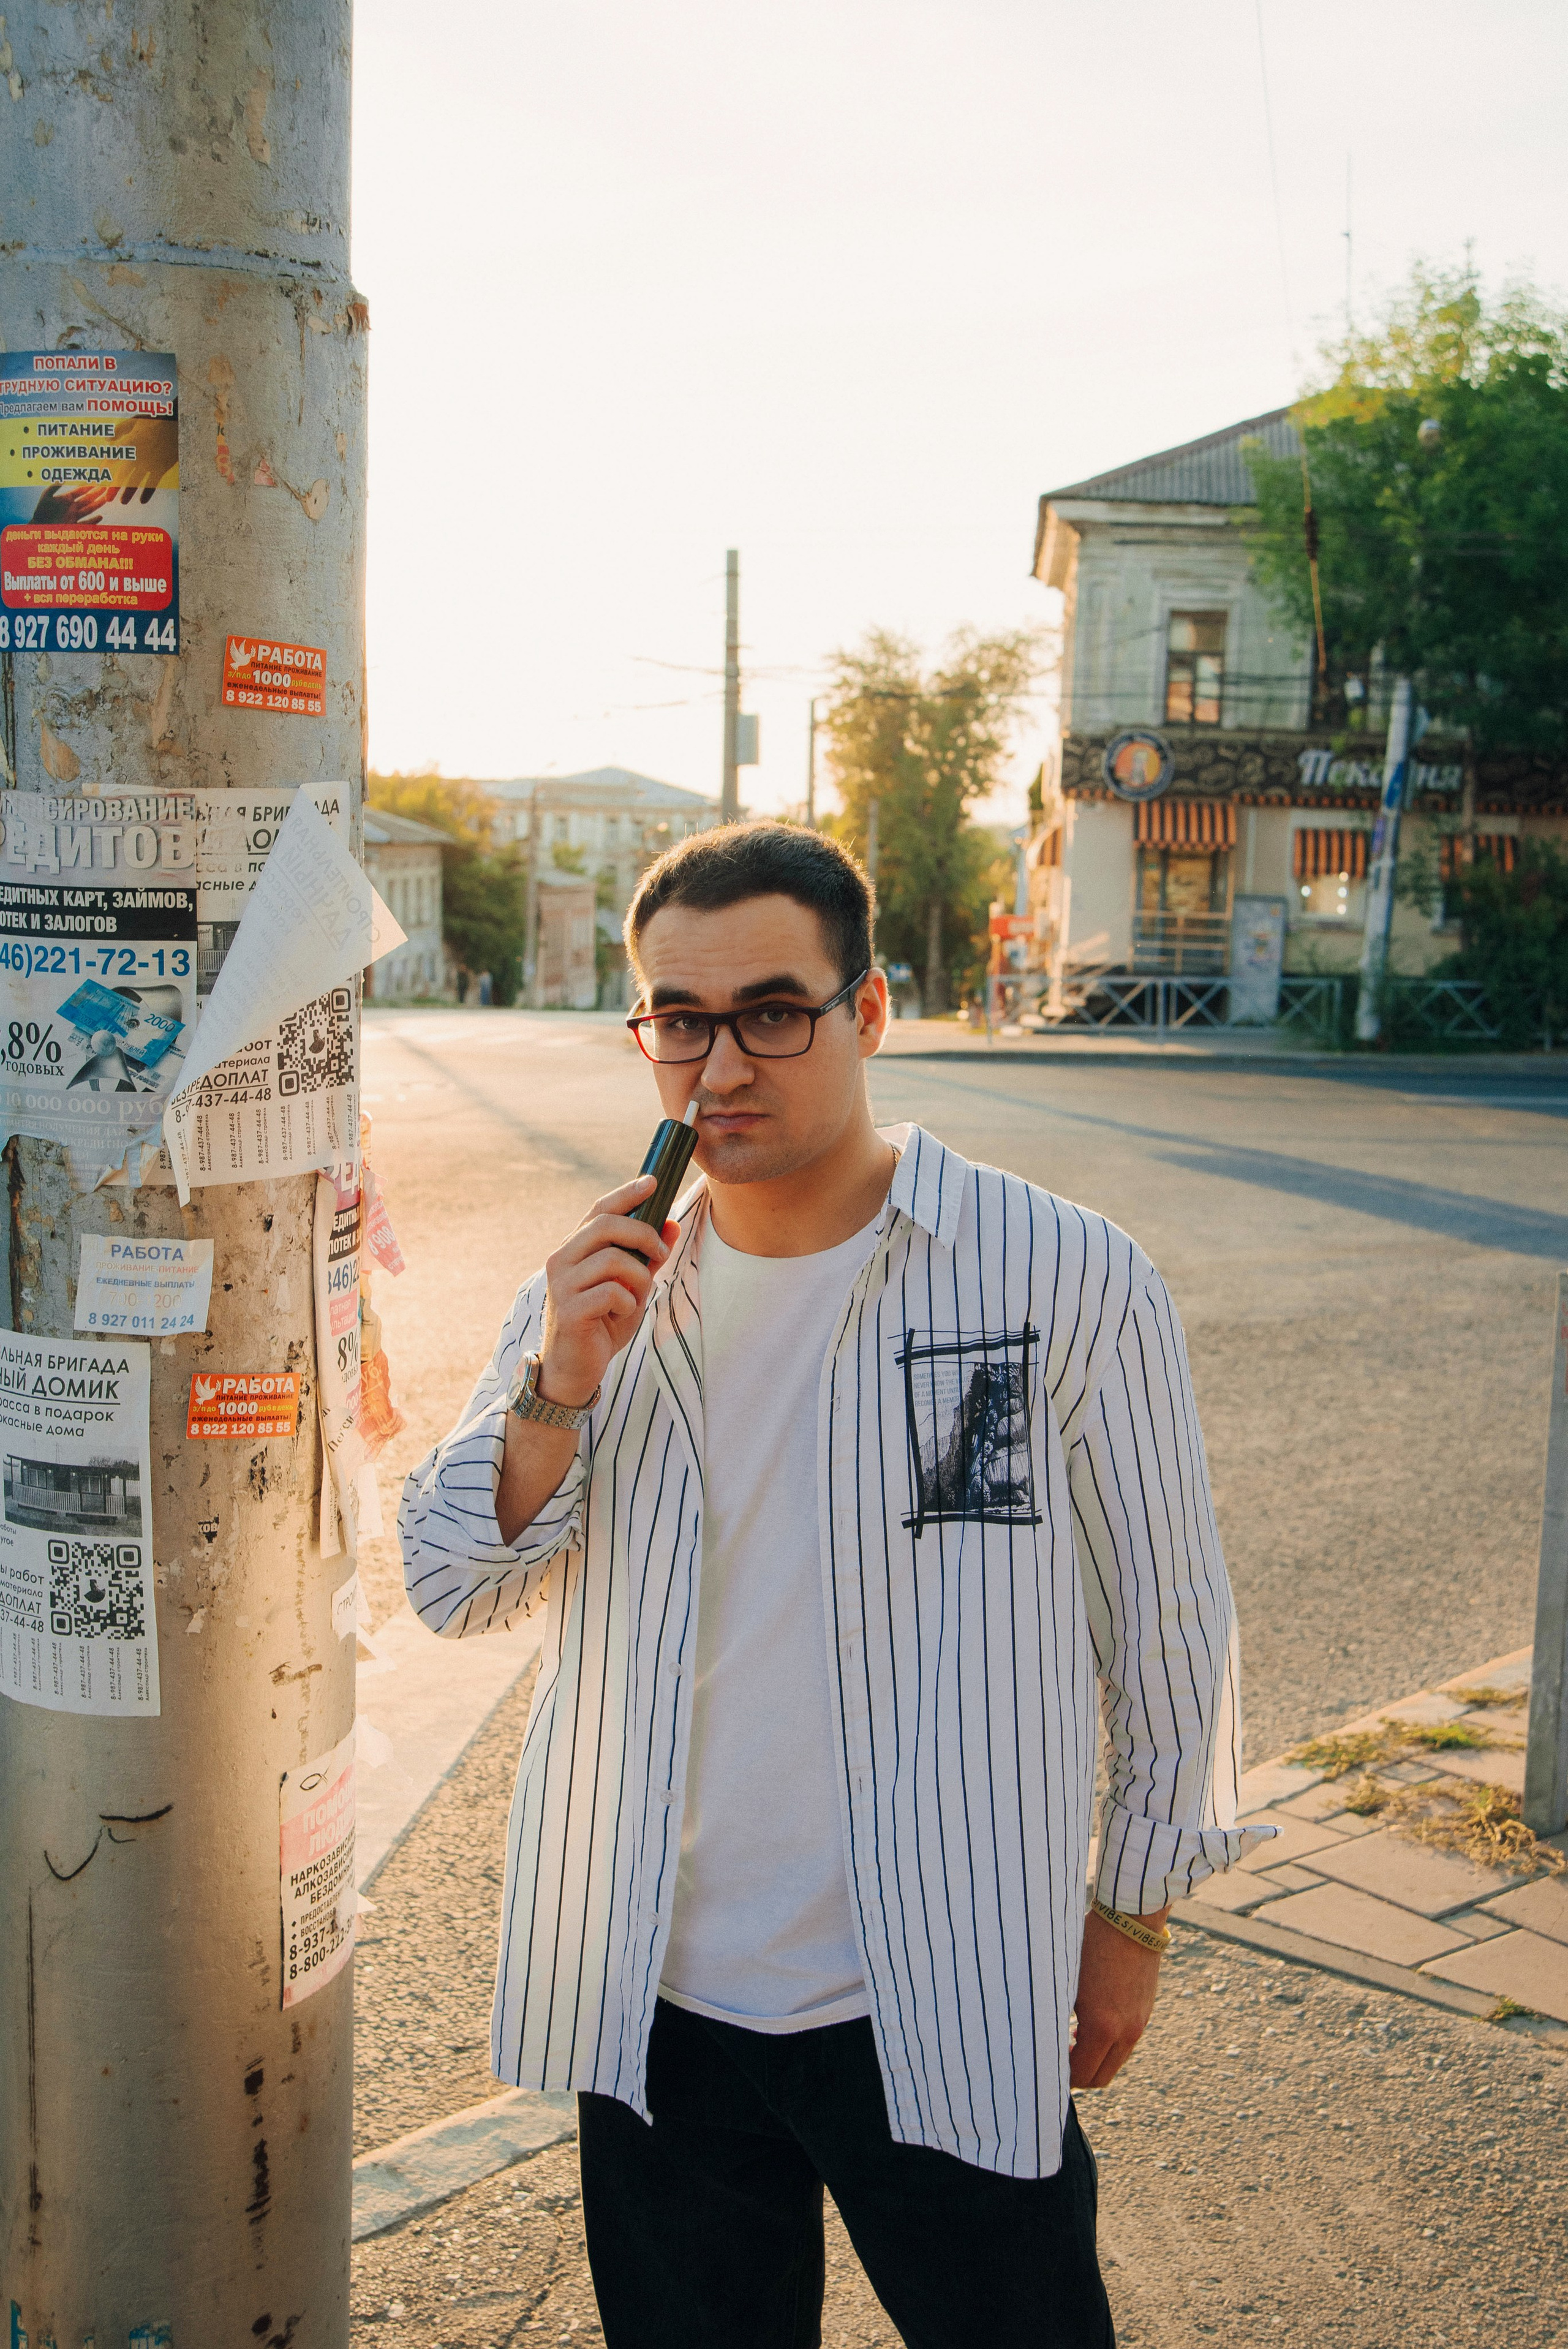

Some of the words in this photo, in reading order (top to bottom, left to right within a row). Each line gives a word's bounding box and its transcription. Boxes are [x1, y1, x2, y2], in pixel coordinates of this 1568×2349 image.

[34, 357, 100, 371] ПОПАЛИ
[105, 358, 116, 370] В
[65, 379, 172, 394] СИТУАЦИЮ?
[88, 400, 173, 415] ПОМОЩЬ!
[37, 424, 115, 436] ПИТАНИЕ
[23, 447, 136, 459] ПРОЖИВАНИЕ
[41, 468, 111, 481] ОДЕЖДА
[6, 530, 41, 541] деньги
[44, 530, 108, 541] выдаются
[112, 532, 128, 540] на
[132, 532, 164, 544] руки
[38, 542, 83, 554] каждый
[87, 544, 120, 554] день
[28, 557, 52, 568] БЕЗ
[56, 557, 134, 570] ОБМАНА!!!
[4, 571, 56, 590] Выплаты
[60, 576, 75, 590] от
[78, 571, 104, 590] 600
[110, 577, 118, 590] и
[124, 578, 167, 592] выше
[34, 594, 53, 603] вся
[56, 592, 138, 605] переработка
[15, 615, 50, 648] 927
[56, 615, 98, 649] 690
[105, 616, 137, 650] 44
[145, 618, 176, 651] 44
[257, 644, 323, 671] РАБОТА
[251, 662, 282, 671] ПИТАНИЕ
[284, 666, 322, 677] ПРОЖИВАНИЕ
[253, 670, 292, 688] 1000
[227, 682, 287, 695] еженедельные
[290, 690, 321, 699] выплаты!
[226, 690, 235, 701] 8
[238, 692, 263, 705] 922
[267, 695, 289, 708] 120
[292, 698, 305, 711] 85
[307, 700, 322, 712] 55
[63, 891, 108, 910] КАРТ,
[113, 888, 193, 911] ЗАЙМОВ,
[0, 910, 28, 929] ОТЕК
[31, 913, 40, 929] И
[45, 914, 118, 933] ЗАЛОГОВ
[144, 1014, 175, 1033] 2000
[6, 1092, 21, 1106] 10
[26, 1095, 61, 1111] 000
[68, 1098, 111, 1114] 000
[197, 1115, 206, 1171] 8-987-437-44-48
[229, 1112, 238, 1168] 8-987-437-44-48
[372, 1225, 396, 1249] 908
[111, 1244, 184, 1261] РАБОТА
[96, 1277, 152, 1288] ЕЖЕДНЕВНЫЕ
[88, 1313, 97, 1324] 8
[102, 1314, 127, 1327] 927
[132, 1316, 154, 1329] 011
[161, 1317, 176, 1329] 24
[179, 1314, 194, 1327] 24
[48, 1354, 130, 1375] БРИГАДА
[913, 1371, 940, 1380] SOMETIES
[32, 1375, 120, 1400] ДОМИК
[222, 1378, 295, 1394] РАБОТА
[34, 1405, 40, 1416] в
[45, 1408, 115, 1423] подарок
[218, 1401, 258, 1415] 1000
[46, 1425, 85, 1437] дома
[190, 1423, 199, 1435] 8
[203, 1424, 227, 1435] 922
[231, 1423, 255, 1434] 120
[257, 1422, 273, 1433] 85
[276, 1422, 291, 1433] 55
[10, 1569, 45, 1585] работ
[0, 1580, 43, 1598] материала
